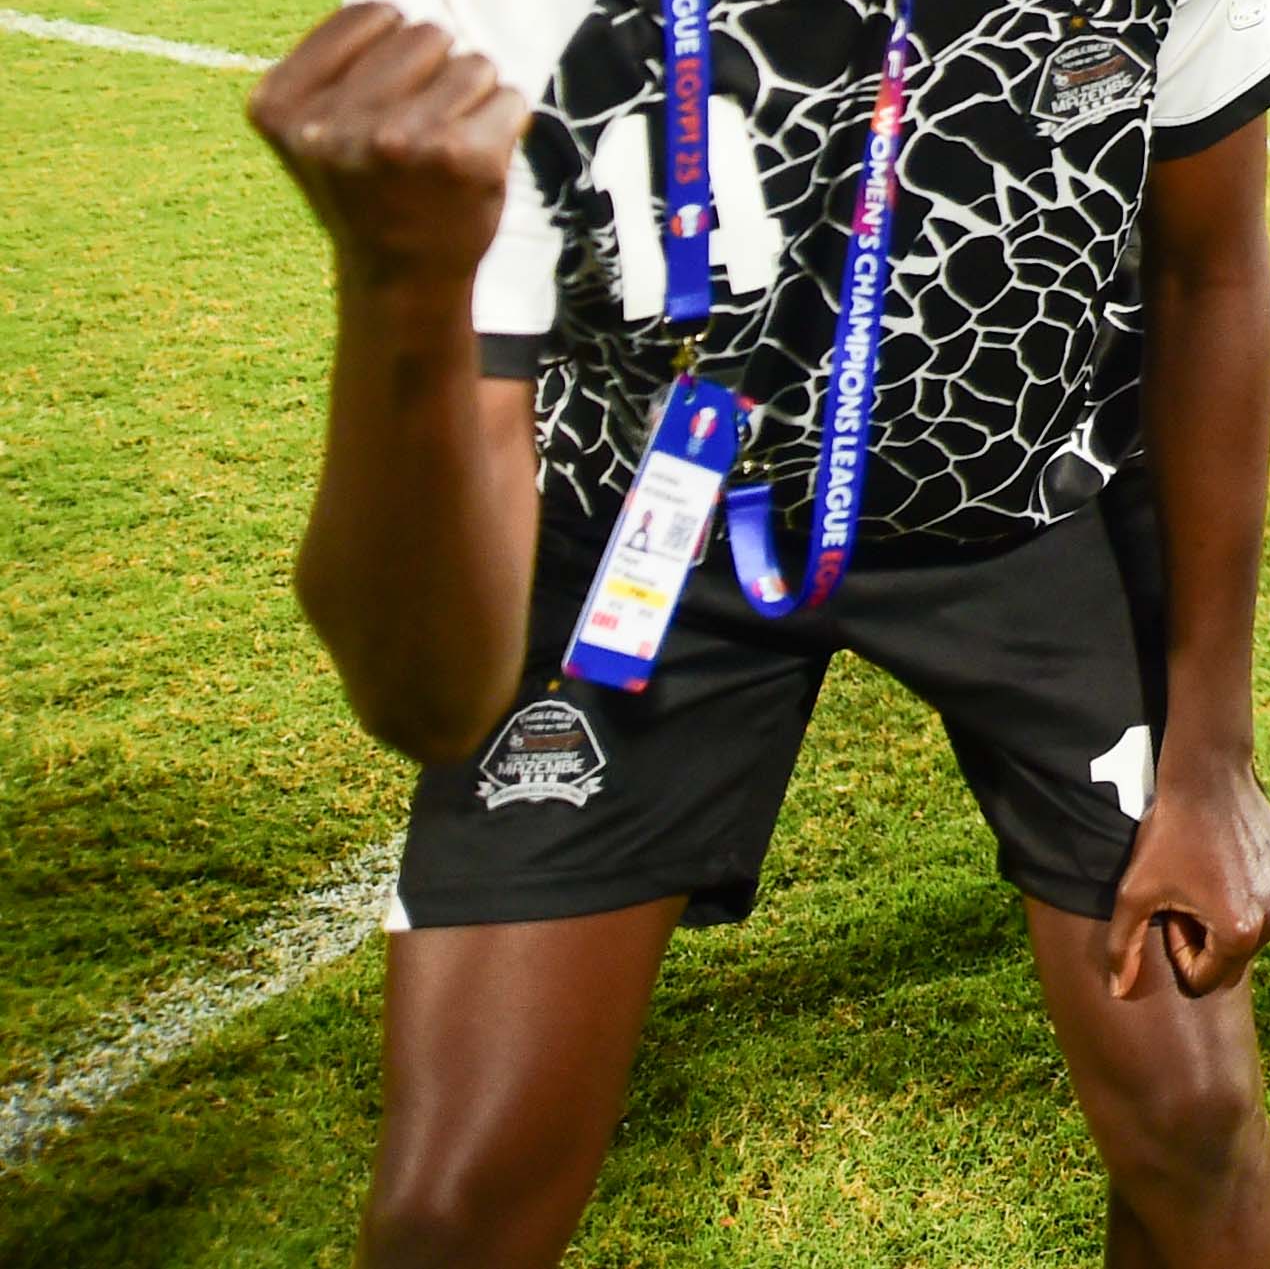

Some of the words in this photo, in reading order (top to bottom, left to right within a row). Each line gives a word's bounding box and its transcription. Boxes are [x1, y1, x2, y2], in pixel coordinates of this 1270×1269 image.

[1051, 74, 1134, 114] MAZEMBE
[834, 253, 880, 433] CHAMPIONS
[822, 437, 859, 548] LEAGUE
[497, 756, 586, 776] MAZEMBE
